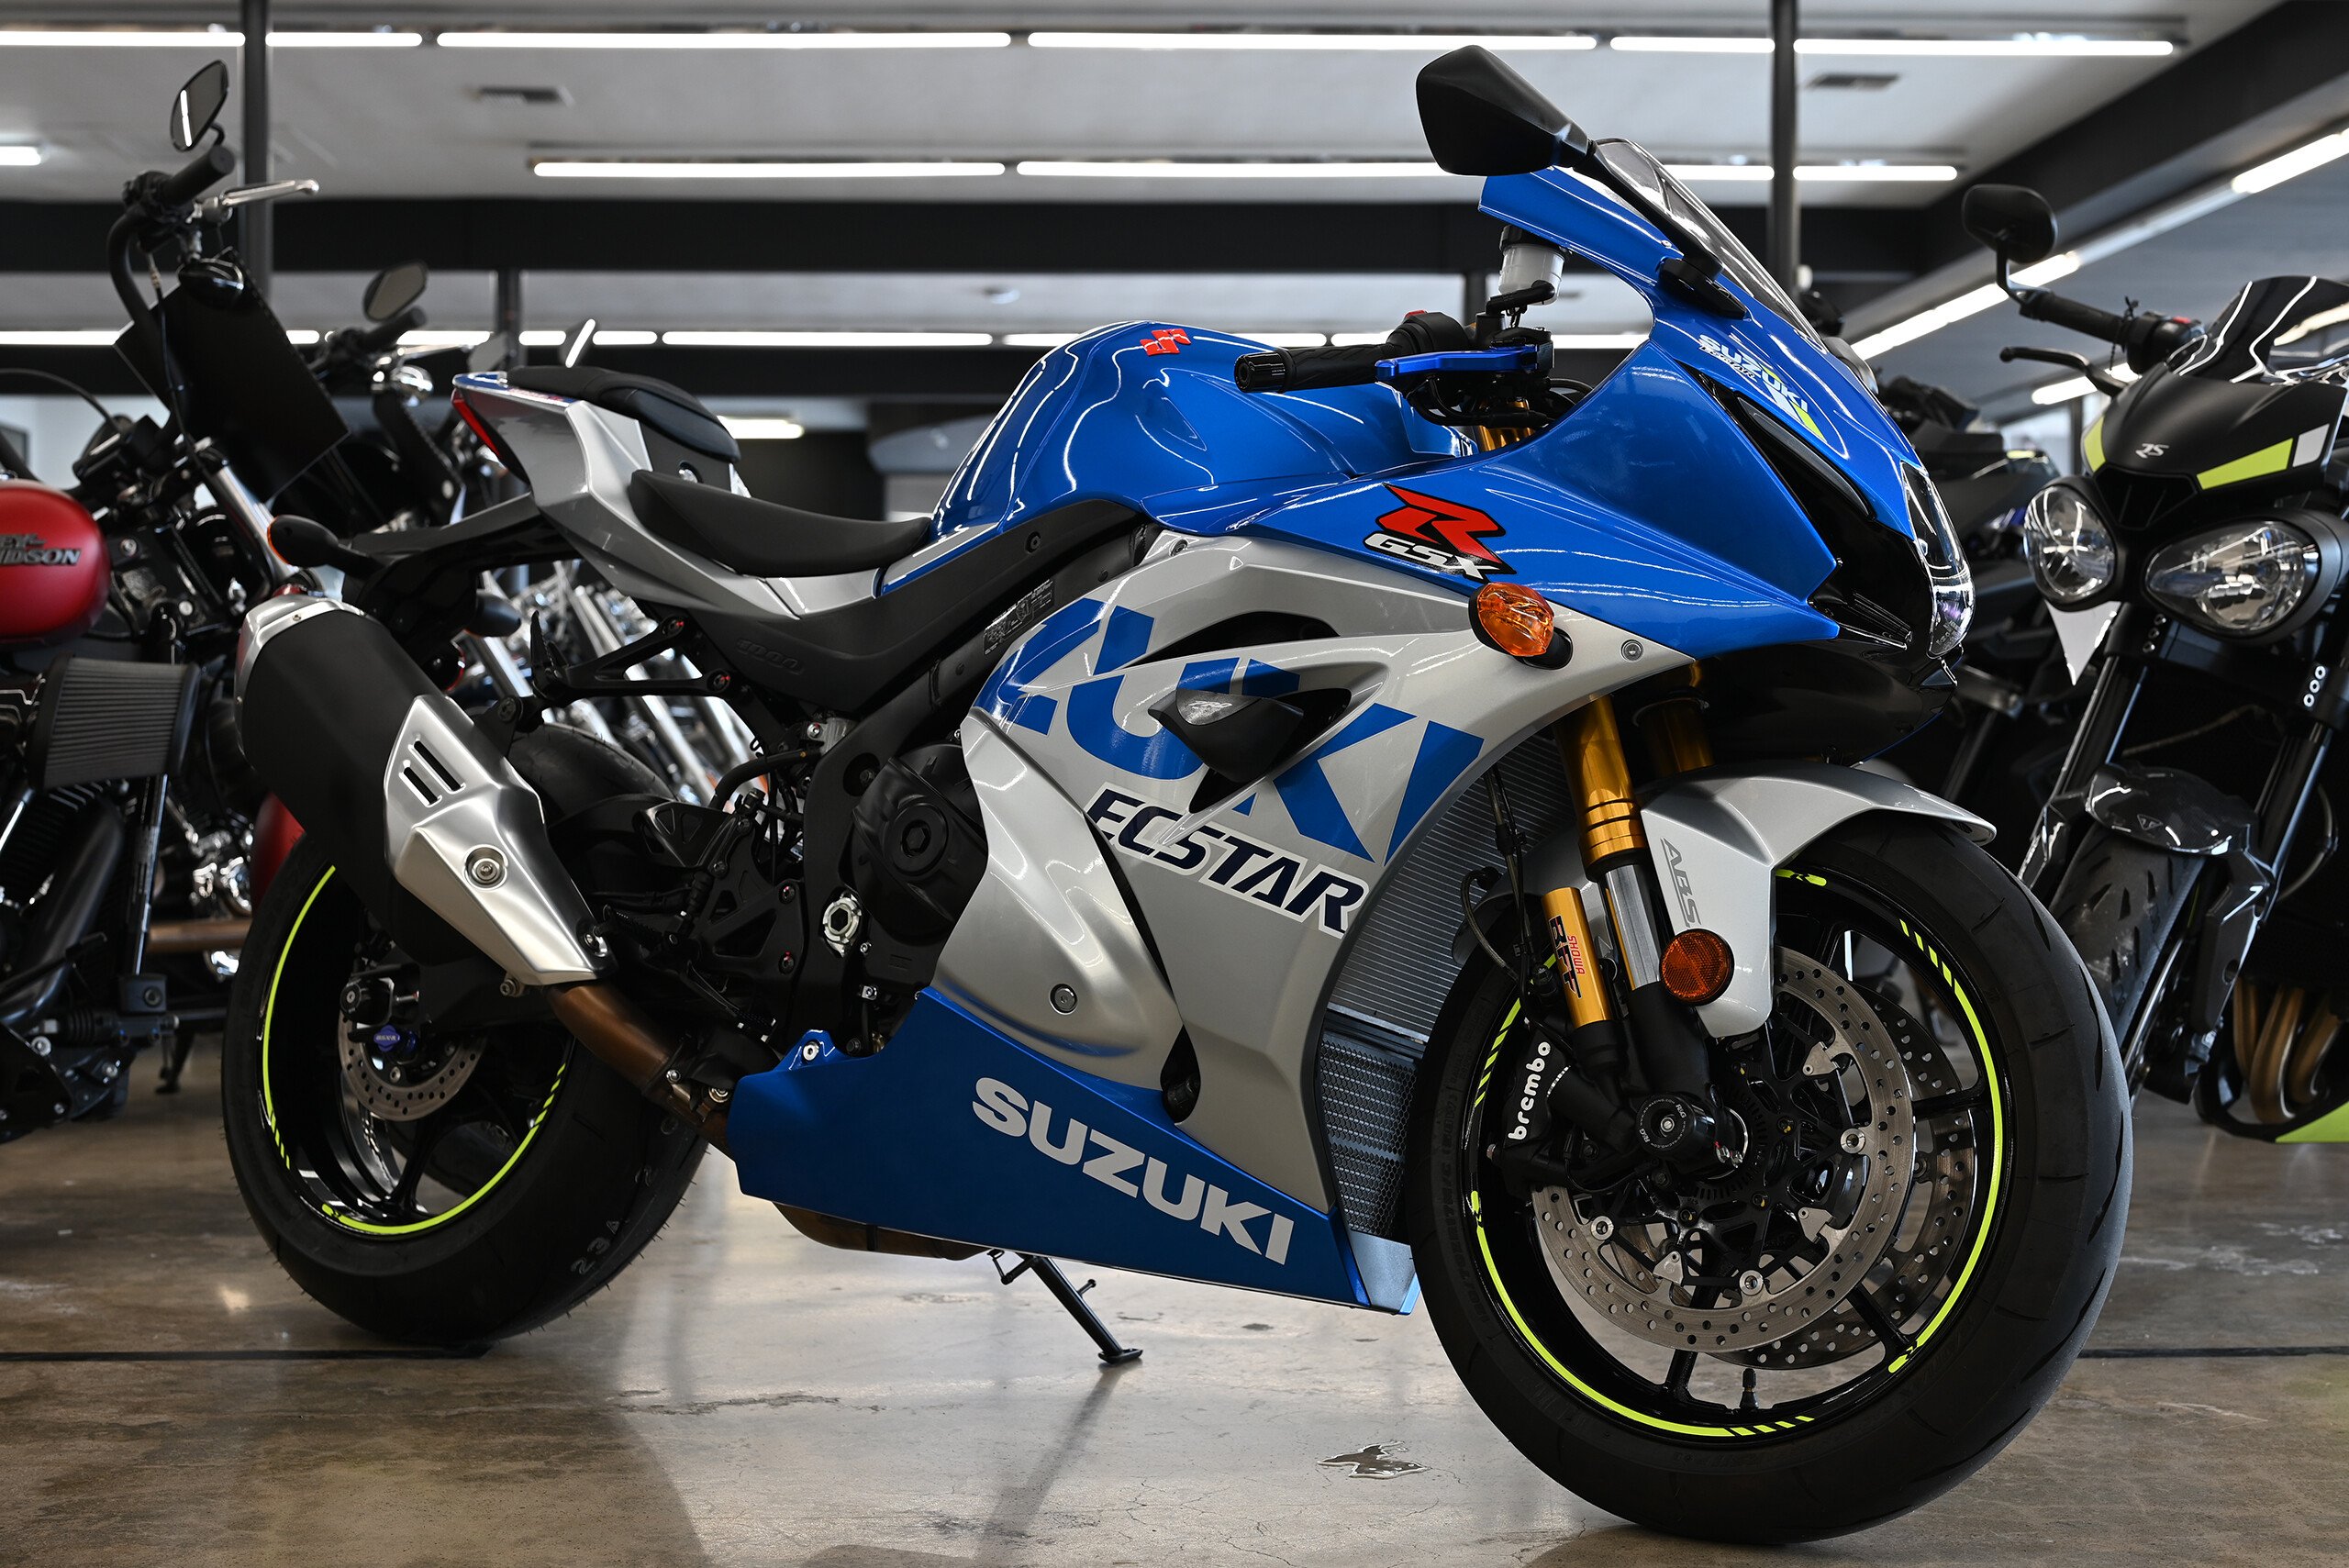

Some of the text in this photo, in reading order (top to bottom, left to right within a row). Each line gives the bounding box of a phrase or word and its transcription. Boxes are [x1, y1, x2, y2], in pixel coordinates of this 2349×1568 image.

[1698, 334, 1809, 413] SUZUKI
[1364, 531, 1501, 582] GSX
[1085, 785, 1366, 936] ECSTAR
[1660, 837, 1701, 928] ABS
[1548, 915, 1582, 999] BFF
[1567, 935, 1586, 974] SHOWA
[1508, 1041, 1551, 1140] brembo
[972, 1076, 1295, 1266] SUZUKI
